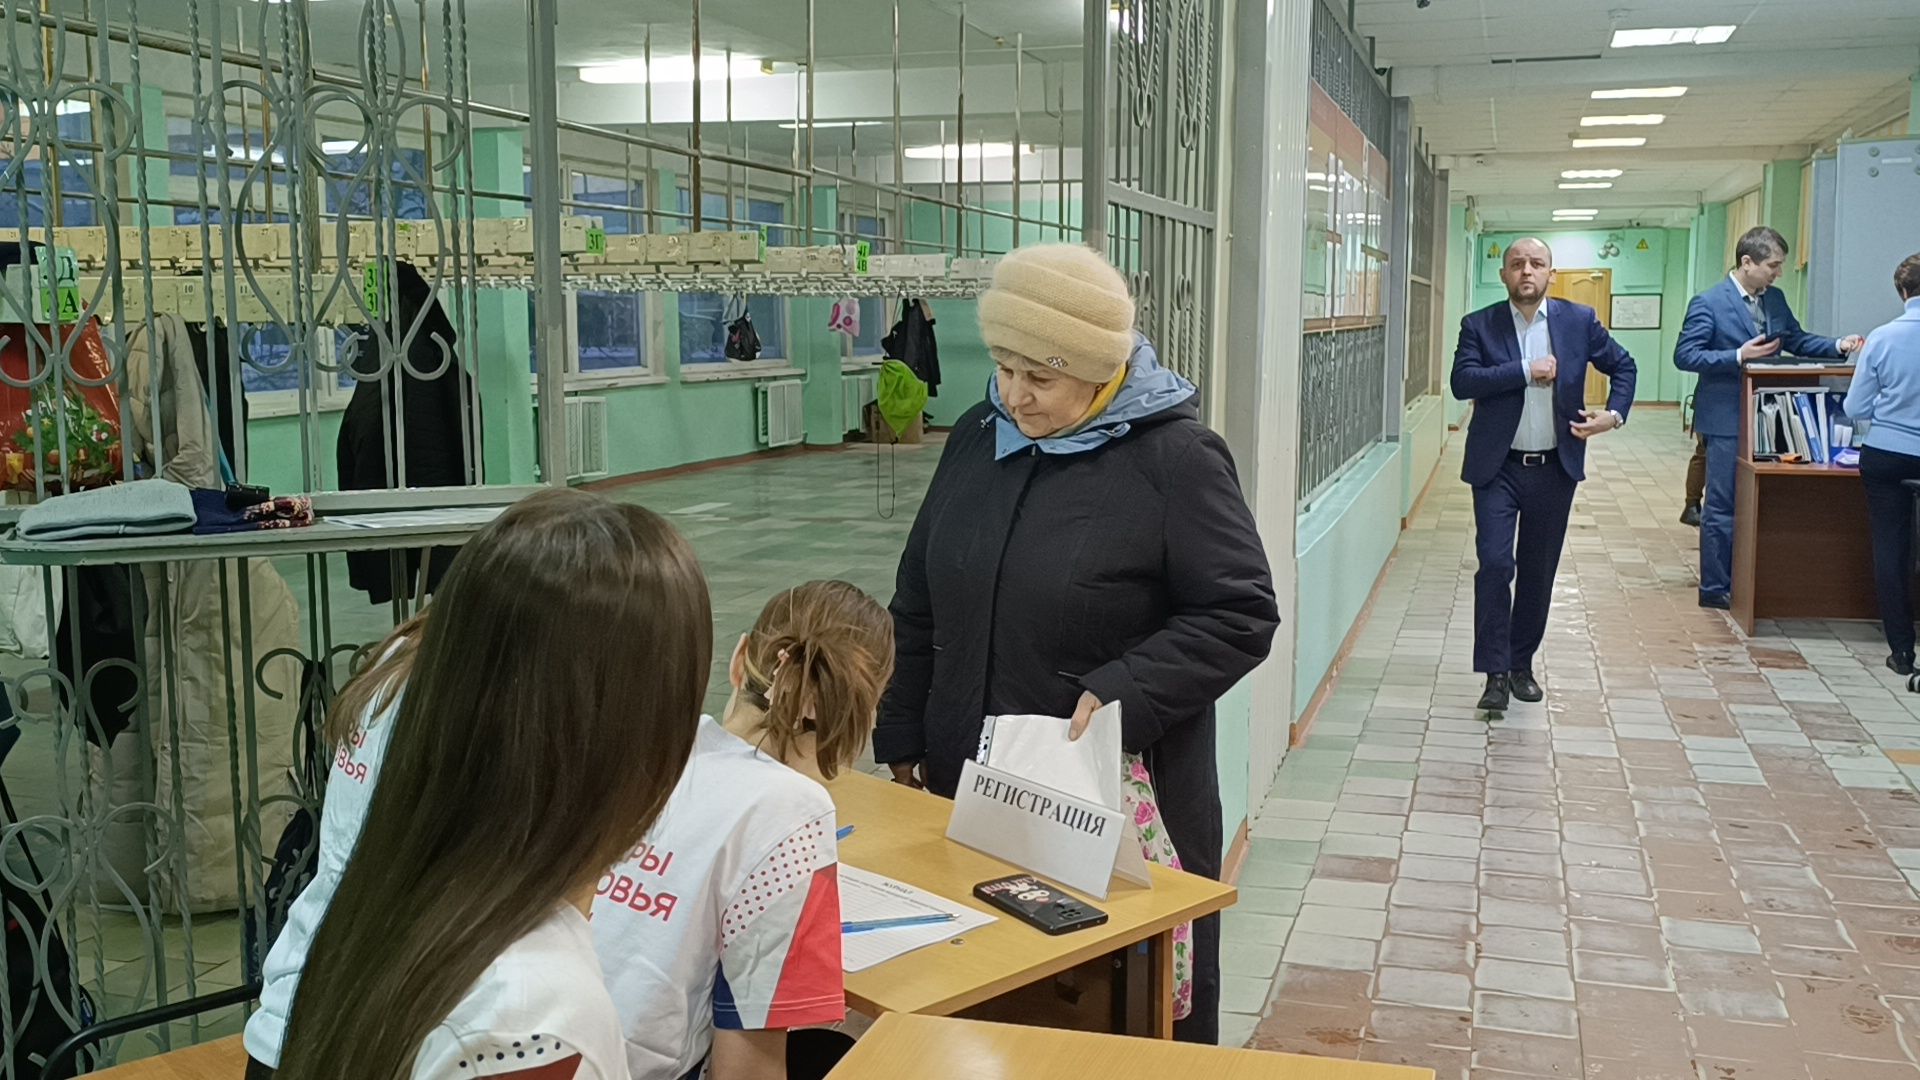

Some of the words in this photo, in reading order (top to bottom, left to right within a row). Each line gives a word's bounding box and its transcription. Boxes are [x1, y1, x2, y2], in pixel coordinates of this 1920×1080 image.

[184, 285, 194, 294] 10
[334, 747, 368, 785] ВЬЯ
[973, 774, 1107, 838] РЕГИСТРАЦИЯ
[611, 841, 674, 877] РЫ
